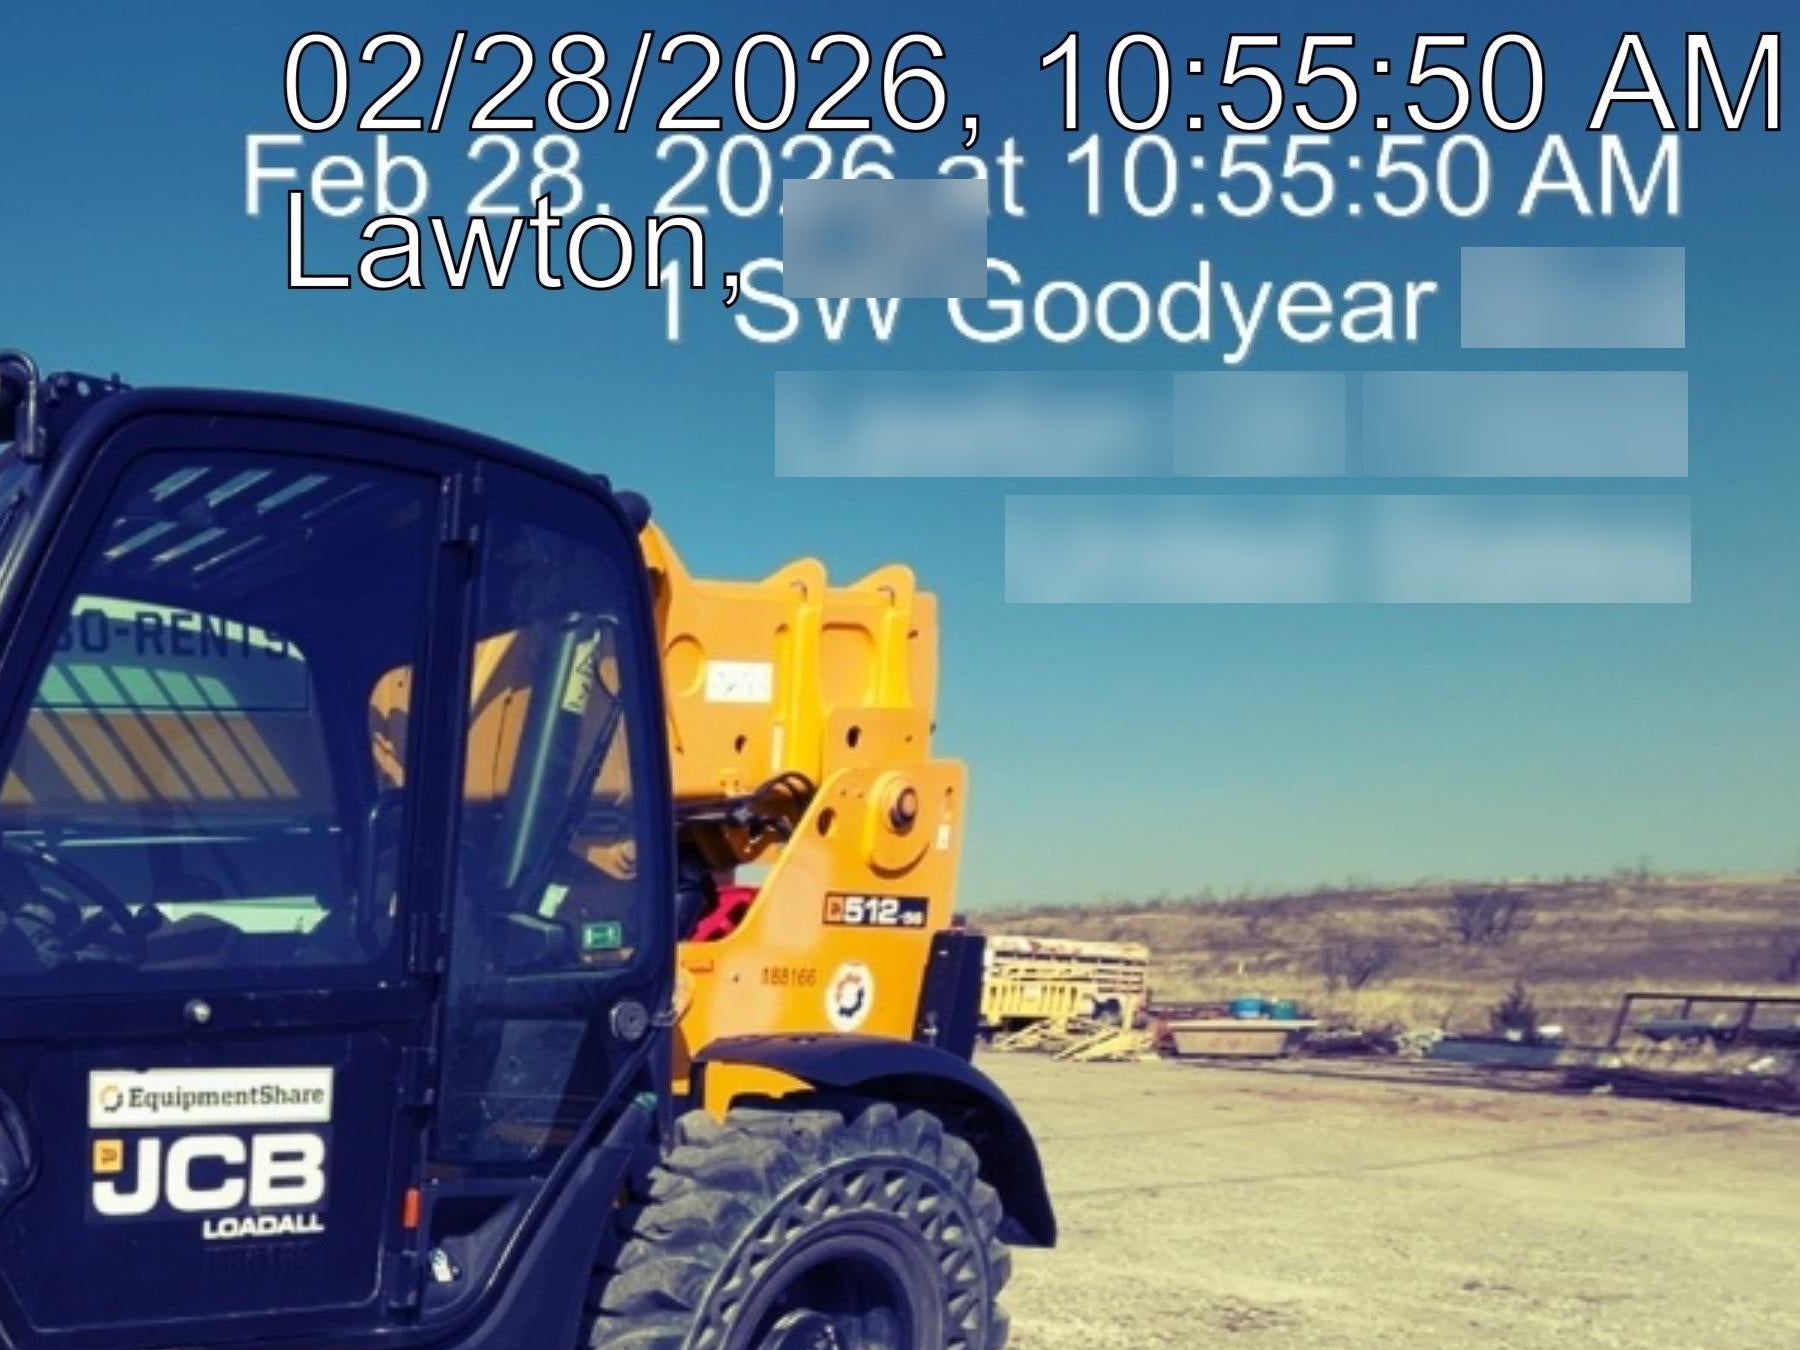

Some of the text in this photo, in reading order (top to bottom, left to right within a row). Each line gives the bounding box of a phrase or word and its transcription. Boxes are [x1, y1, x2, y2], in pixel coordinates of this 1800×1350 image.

[128, 1085, 326, 1113] EquipmentShare
[92, 1133, 326, 1216] JCB
[202, 1212, 326, 1240] LOADALL
